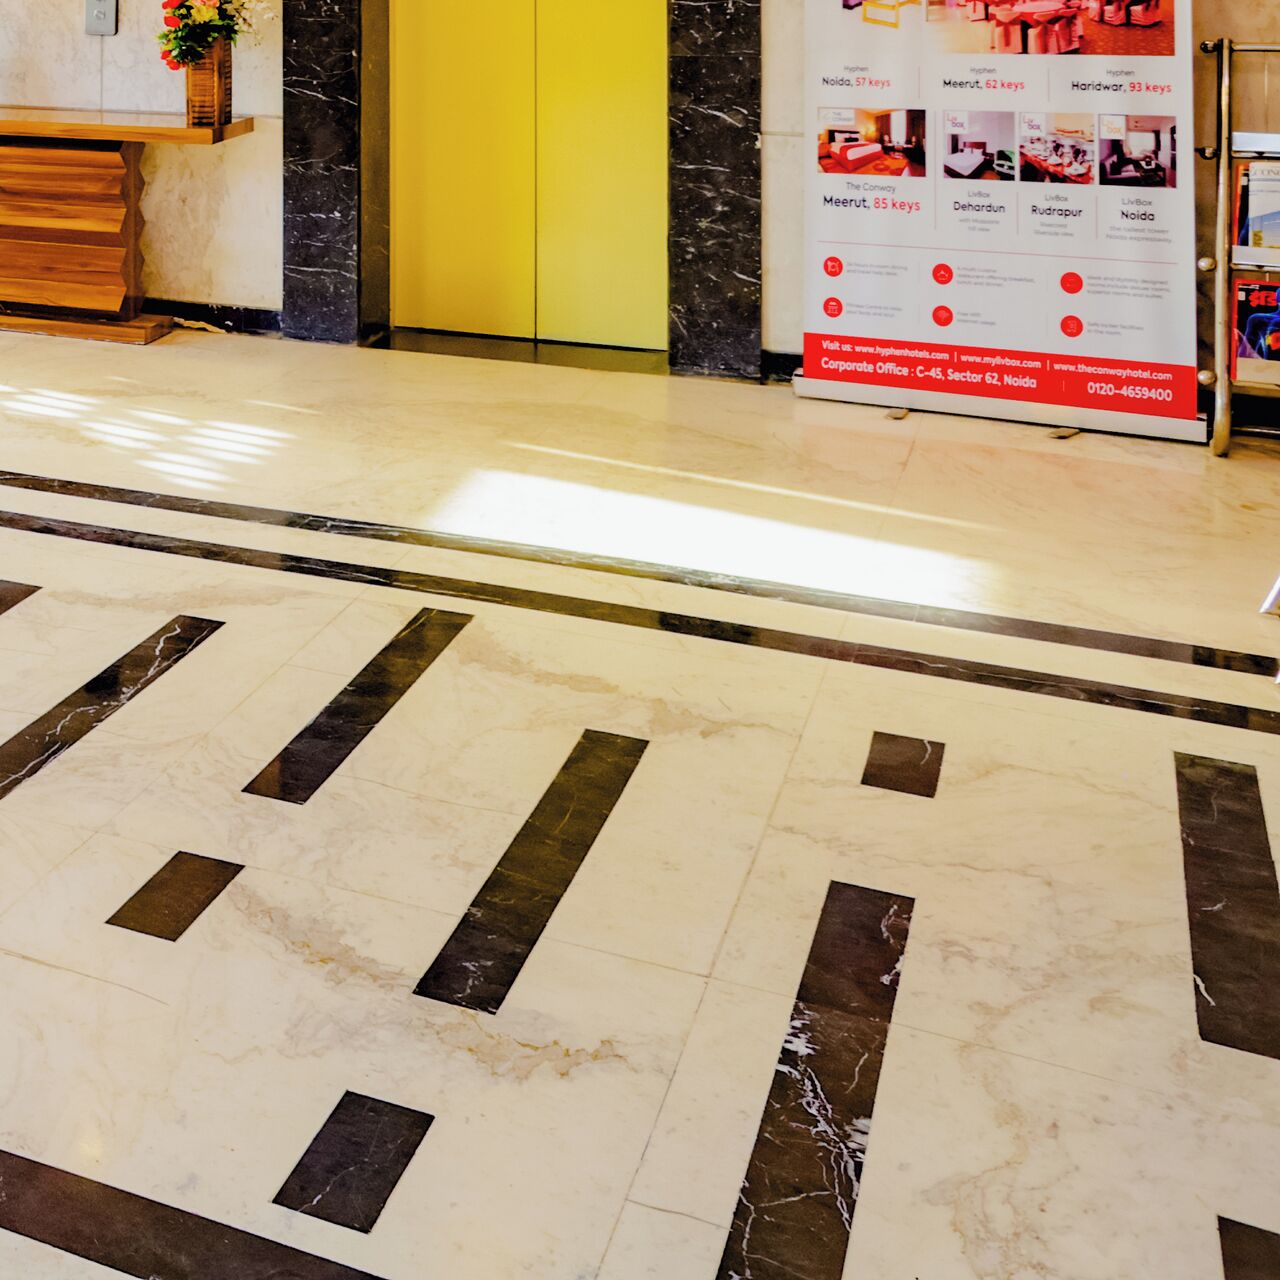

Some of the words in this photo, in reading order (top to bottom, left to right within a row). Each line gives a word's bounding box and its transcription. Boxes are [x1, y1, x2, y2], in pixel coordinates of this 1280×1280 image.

[1106, 69, 1135, 77] Hyphen
[822, 77, 853, 88] Noida,
[855, 77, 866, 86] 57
[868, 77, 891, 89] keys
[943, 80, 983, 90] Meerut,
[985, 80, 998, 88] 62
[1001, 80, 1025, 91] keys
[1071, 81, 1127, 93] Haridwar,
[1129, 82, 1142, 92] 93
[1145, 83, 1172, 95] keys
[846, 182, 861, 190] The
[863, 183, 896, 194] Conway
[823, 196, 870, 210] Meerut,
[873, 197, 888, 209] 85
[891, 199, 921, 213] keys
[953, 201, 1005, 213] Dehardun
[1121, 198, 1152, 206] LivBox
[1032, 205, 1082, 218] Rudrapur
[1121, 210, 1155, 221] Noida
[822, 340, 840, 351] Visit
[842, 343, 853, 352] us:
[855, 345, 949, 360] www.hyphenhotels.com
[960, 354, 1042, 368] www.mylivbox.com
[1053, 363, 1173, 380] www.theconwayhotel.com
[821, 357, 874, 373] Corporate
[876, 362, 909, 376] Office
[916, 366, 945, 381] C-45,
[947, 368, 983, 383] Sector
[985, 372, 1002, 386] 62,
[1004, 374, 1037, 388] Noida
[1087, 382, 1173, 401] 0120-4659400
